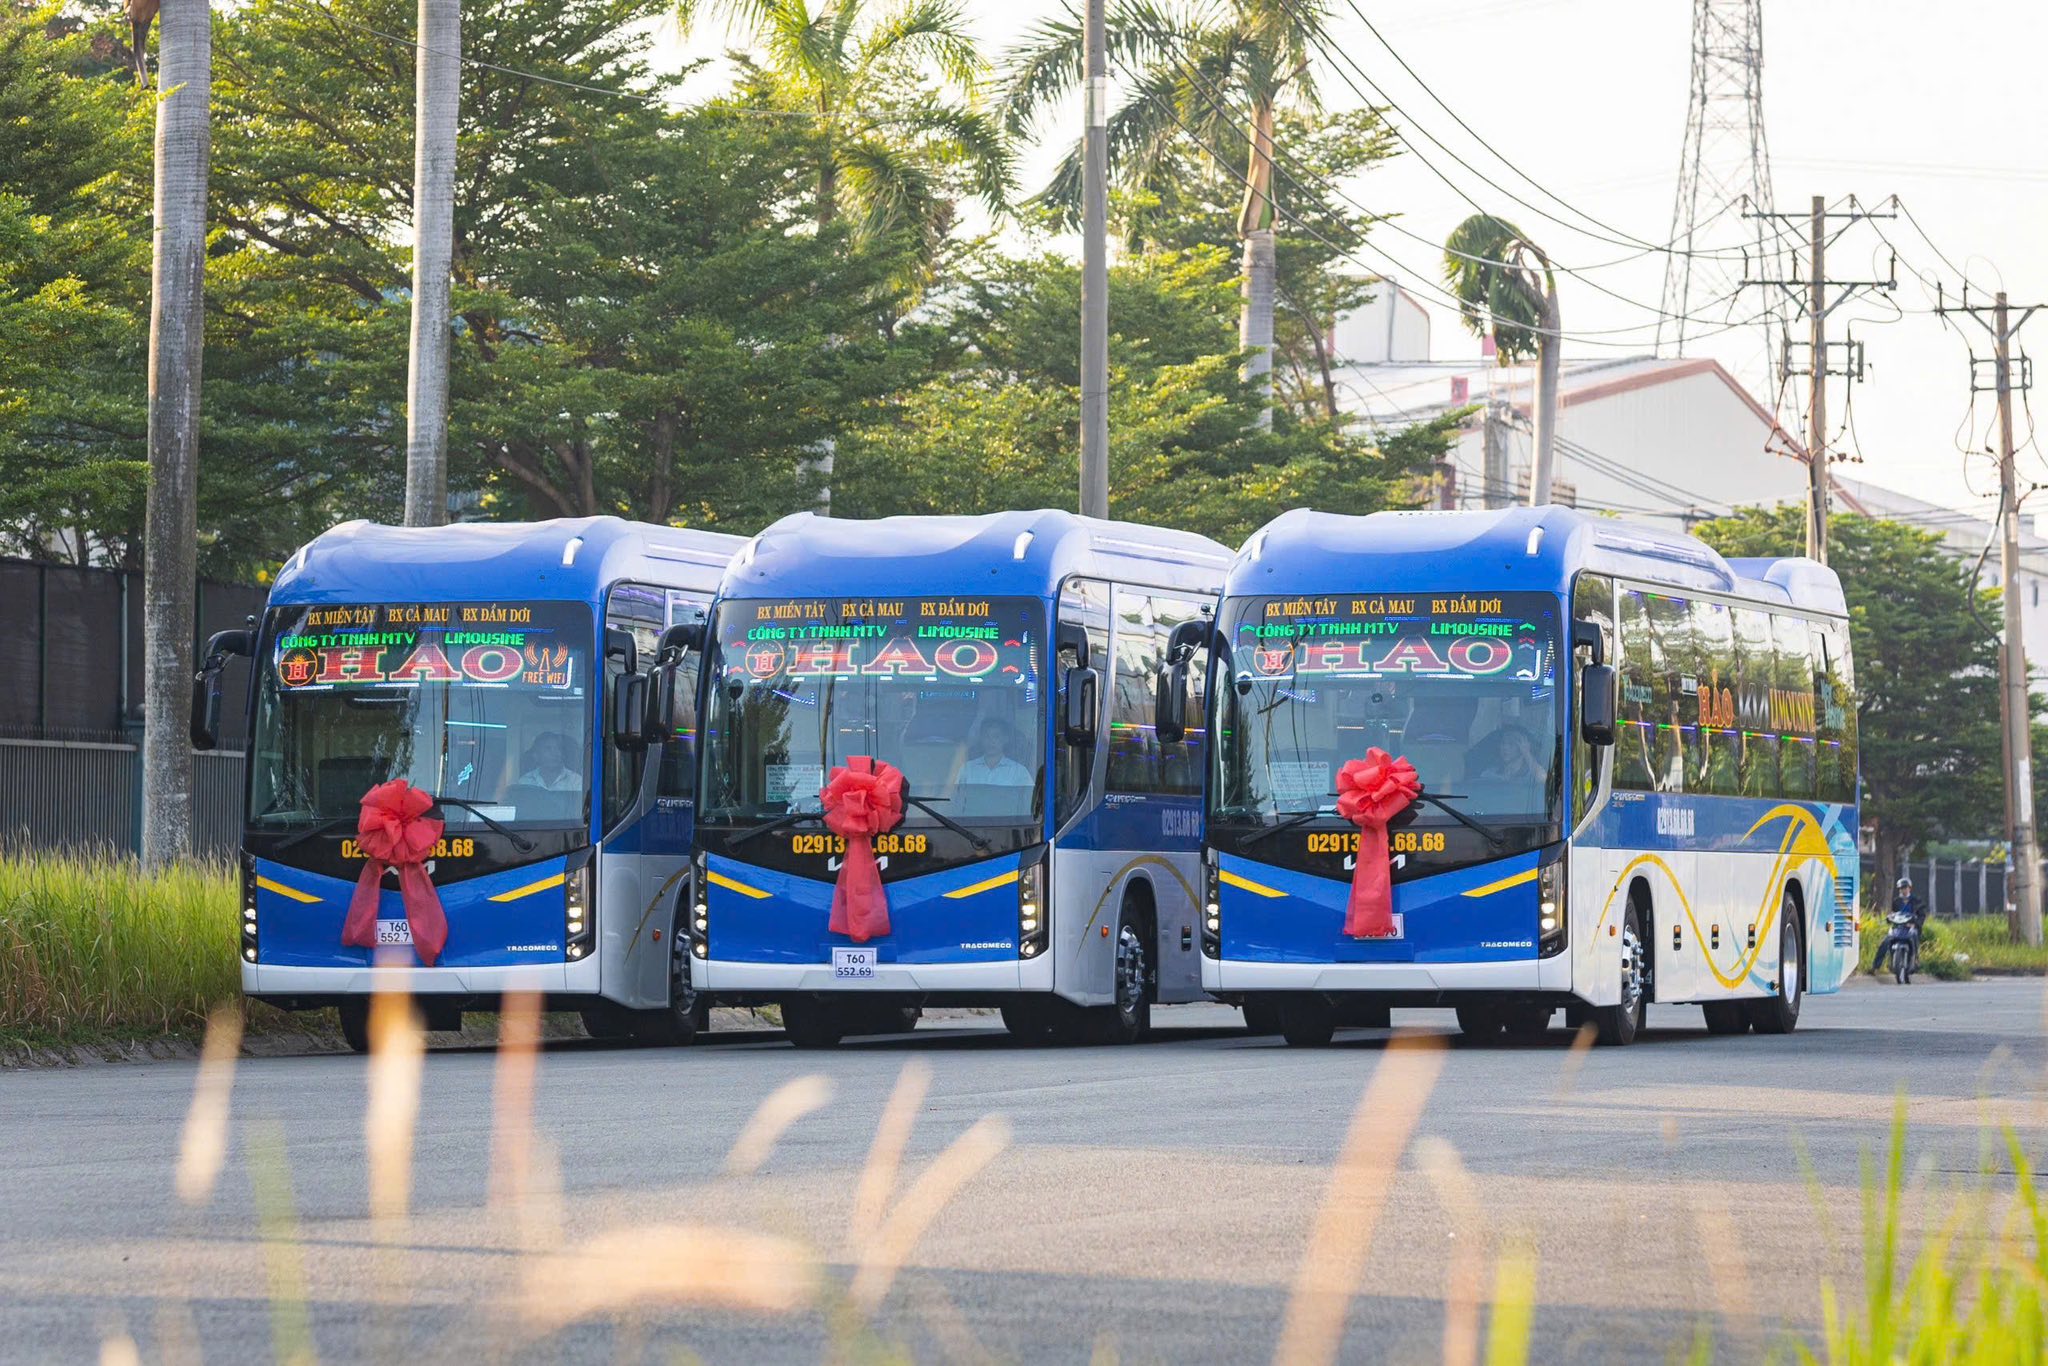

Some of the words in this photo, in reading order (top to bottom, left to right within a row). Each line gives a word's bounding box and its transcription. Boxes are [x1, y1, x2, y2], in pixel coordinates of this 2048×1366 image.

[757, 606, 771, 619] BX
[842, 603, 857, 617] BX
[860, 600, 875, 617] CÀ
[878, 603, 904, 617] MAU
[921, 603, 936, 616] BX
[968, 601, 989, 617] DƠI
[1266, 603, 1280, 617] BX
[1351, 600, 1367, 614] BX
[1370, 597, 1385, 614] CÀ
[1388, 600, 1415, 614] MAU
[1432, 600, 1447, 614] BX
[1480, 598, 1502, 614] DƠI
[308, 612, 322, 625] BX
[389, 608, 403, 622] BX
[406, 605, 421, 622] CÀ
[424, 608, 449, 622] MAU
[463, 608, 477, 621] BX
[510, 607, 531, 622] DƠI
[748, 625, 785, 640] CÔNG
[788, 627, 807, 638] TY
[809, 626, 851, 638] TNHH
[853, 625, 887, 637] MTV
[918, 626, 999, 640] LIMOUSINE
[1256, 623, 1295, 638] CÔNG
[1297, 624, 1316, 636] TY
[1319, 623, 1361, 635] TNHH
[1364, 622, 1399, 634] MTV
[1430, 623, 1513, 637] LIMOUSINE
[281, 634, 318, 649] CÔNG
[320, 635, 337, 647] TY
[340, 633, 379, 646] TNHH
[381, 632, 416, 645] MTV
[445, 632, 524, 646] LIMOUSINE
[522, 671, 544, 684] FREE
[547, 671, 565, 684] WIFI
[390, 922, 408, 932] T60
[506, 944, 558, 952] TRACOMECO
[1480, 940, 1532, 948] TRACOMECO
[846, 954, 866, 964] T60
[837, 966, 872, 976] 552.69
